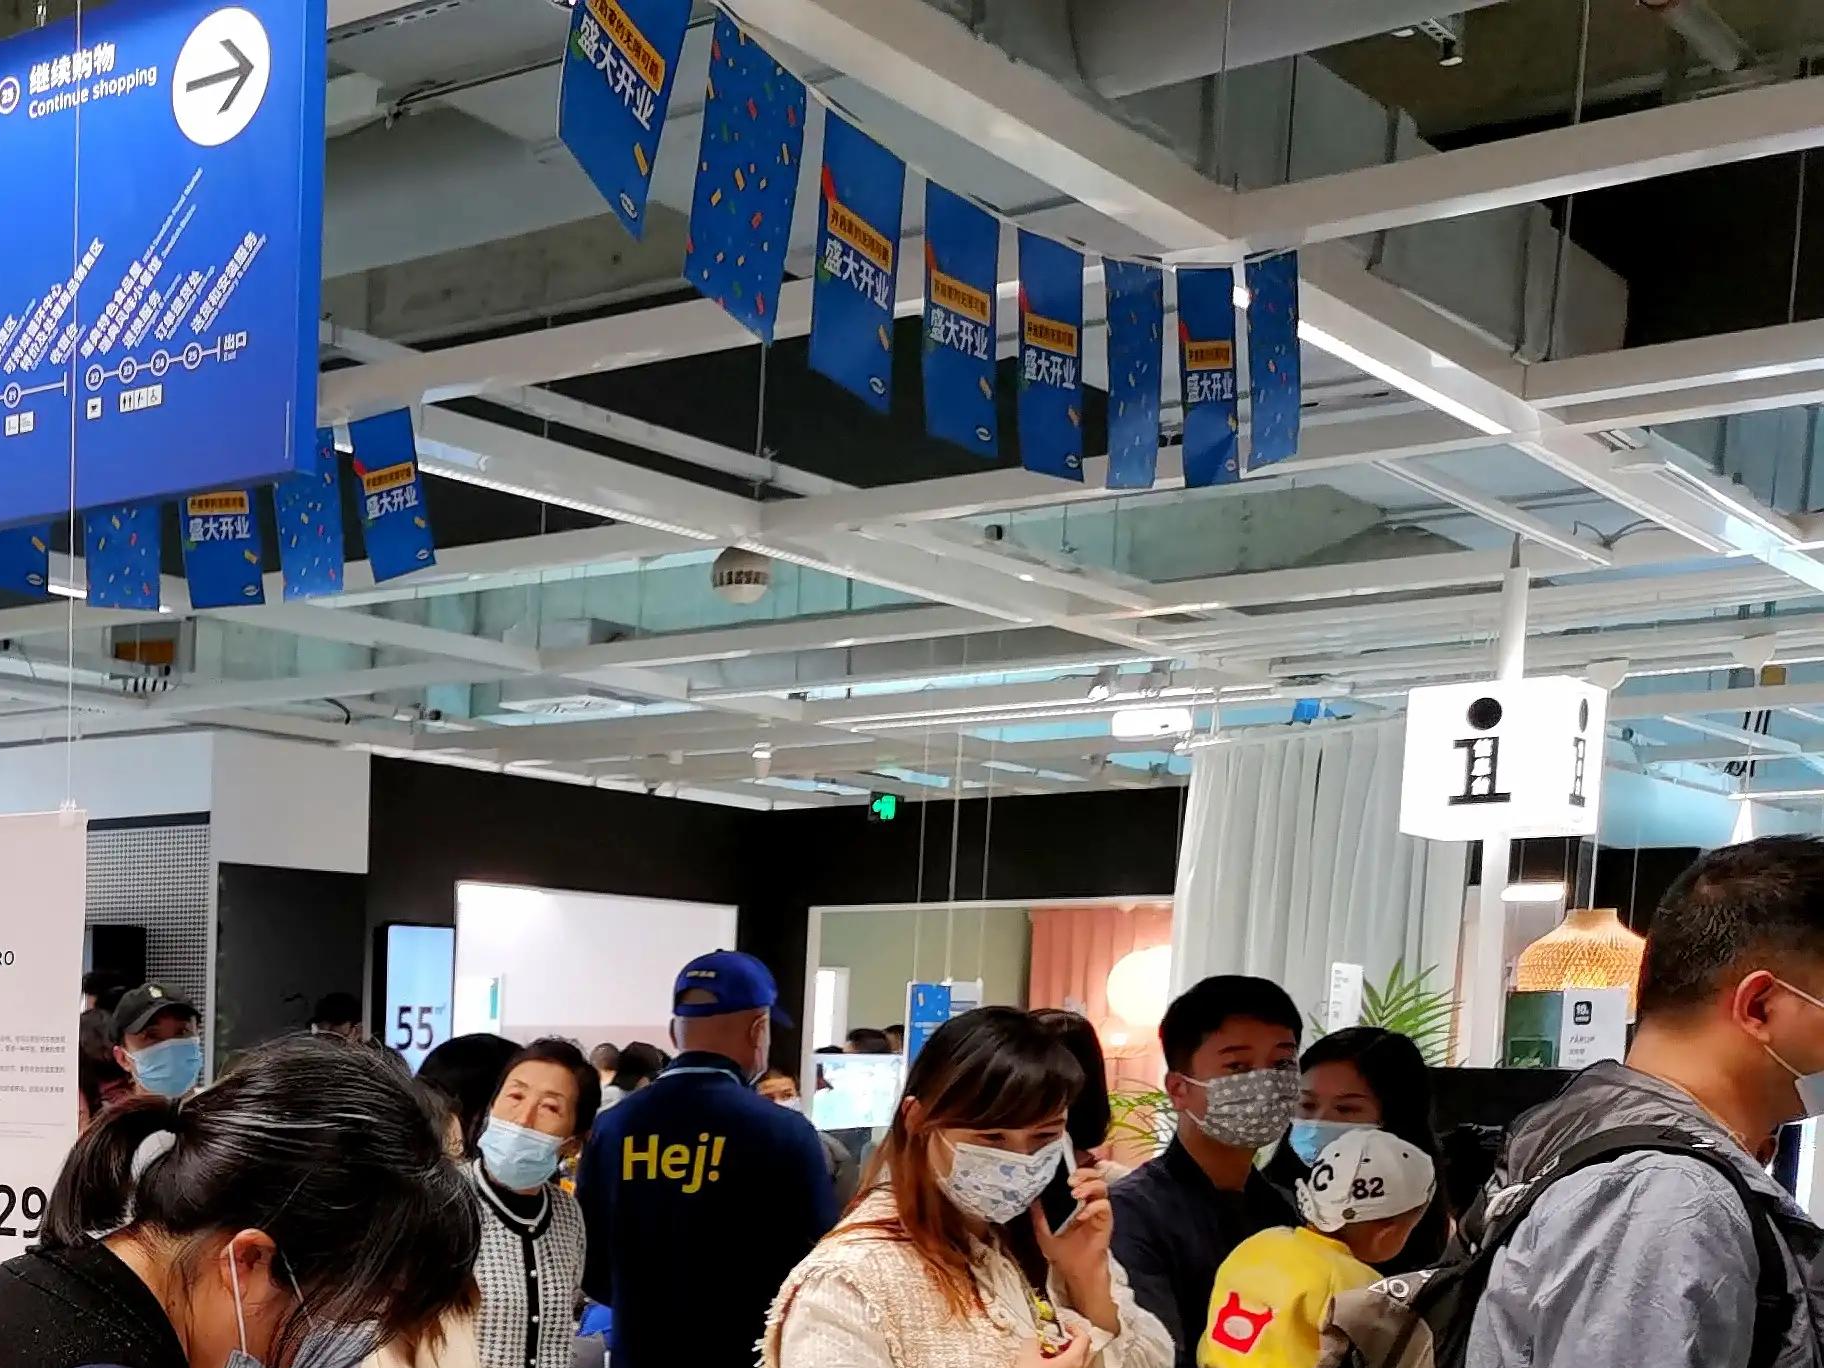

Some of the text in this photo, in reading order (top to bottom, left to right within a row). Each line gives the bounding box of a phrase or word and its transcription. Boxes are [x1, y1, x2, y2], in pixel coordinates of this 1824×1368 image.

[28, 42, 116, 95] 继续购物
[29, 66, 158, 119] Continue shopping
[578, 14, 654, 131] 盛大开业
[824, 237, 889, 311] 盛大开业
[929, 306, 988, 361] 盛大开业
[1024, 347, 1076, 390] 盛大开业
[366, 484, 419, 520] 盛大开业
[189, 516, 251, 542] 盛大开业
[623, 1133, 726, 1194] Hej!
[1352, 1177, 1385, 1200] 82
